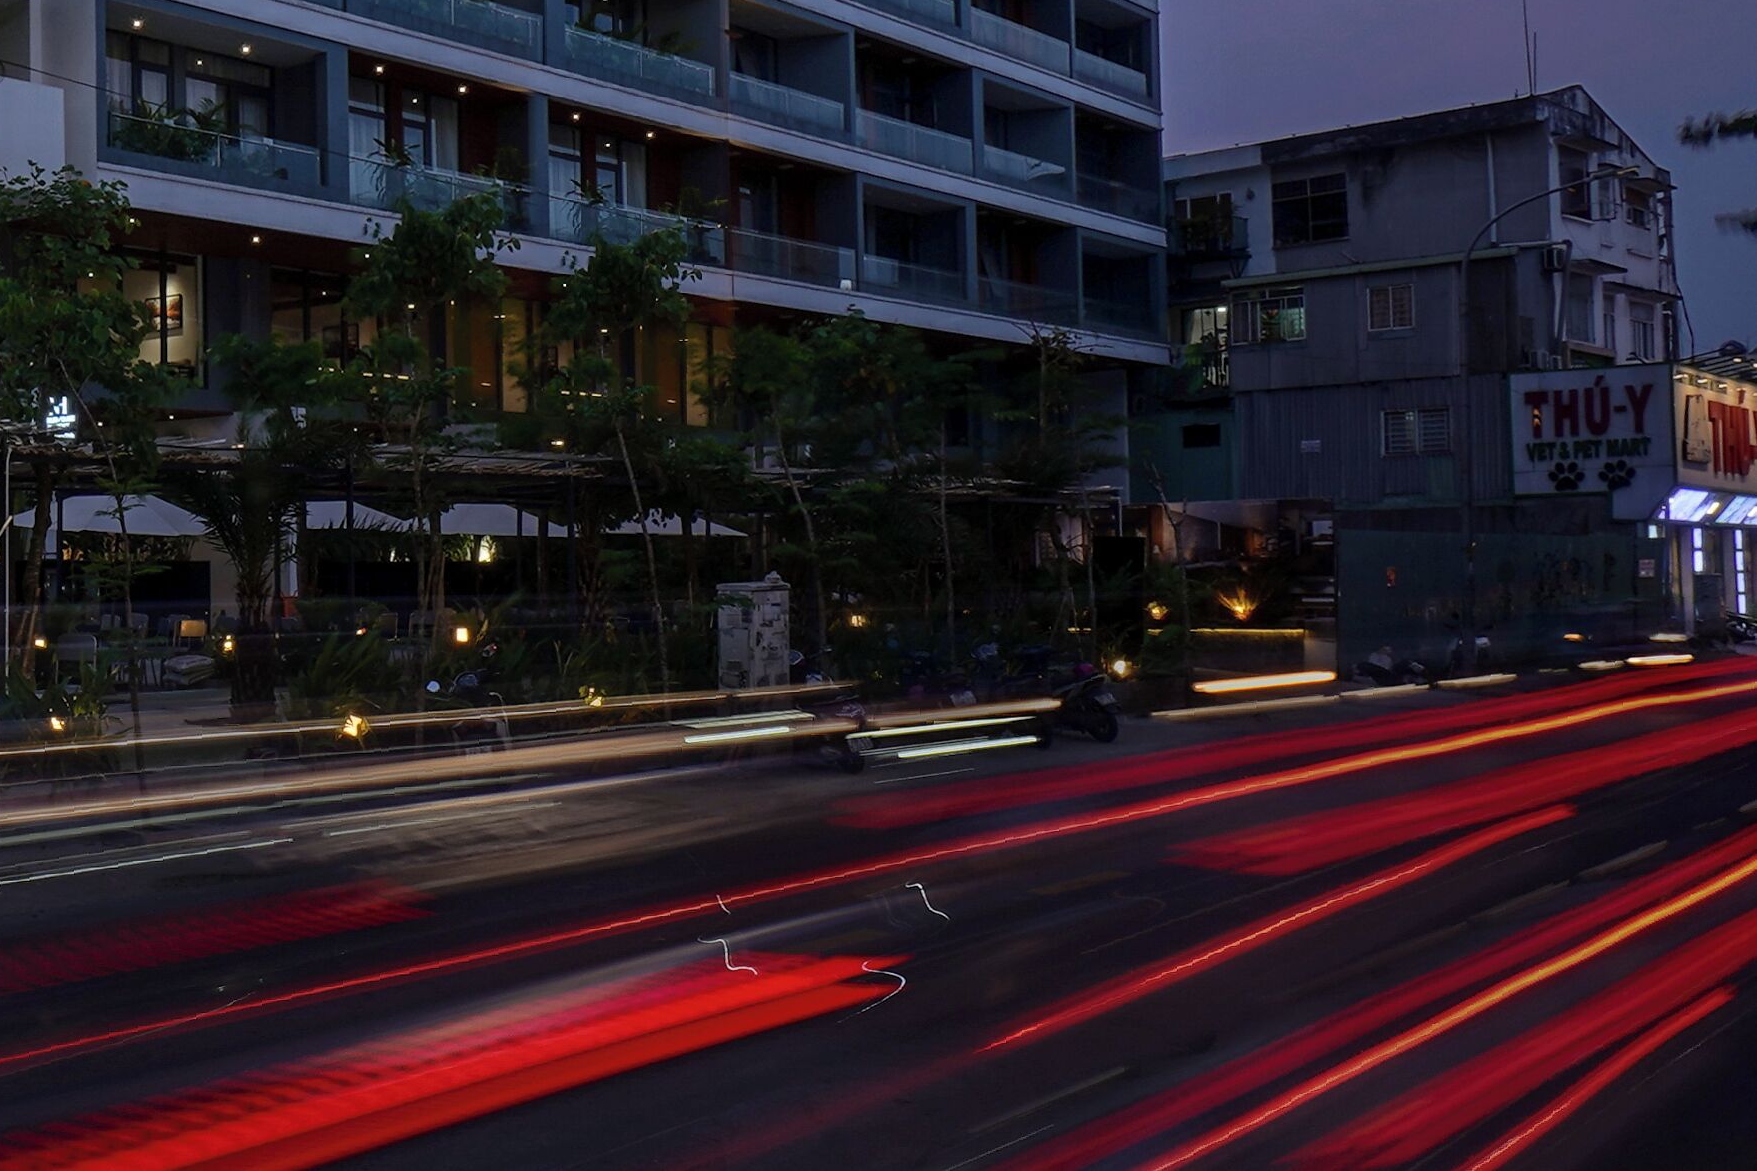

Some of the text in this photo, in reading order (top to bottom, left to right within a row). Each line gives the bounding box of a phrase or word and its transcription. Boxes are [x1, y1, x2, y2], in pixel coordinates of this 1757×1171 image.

[1524, 375, 1653, 439] THÚ-Y
[1526, 436, 1651, 461] VET & PET MART
